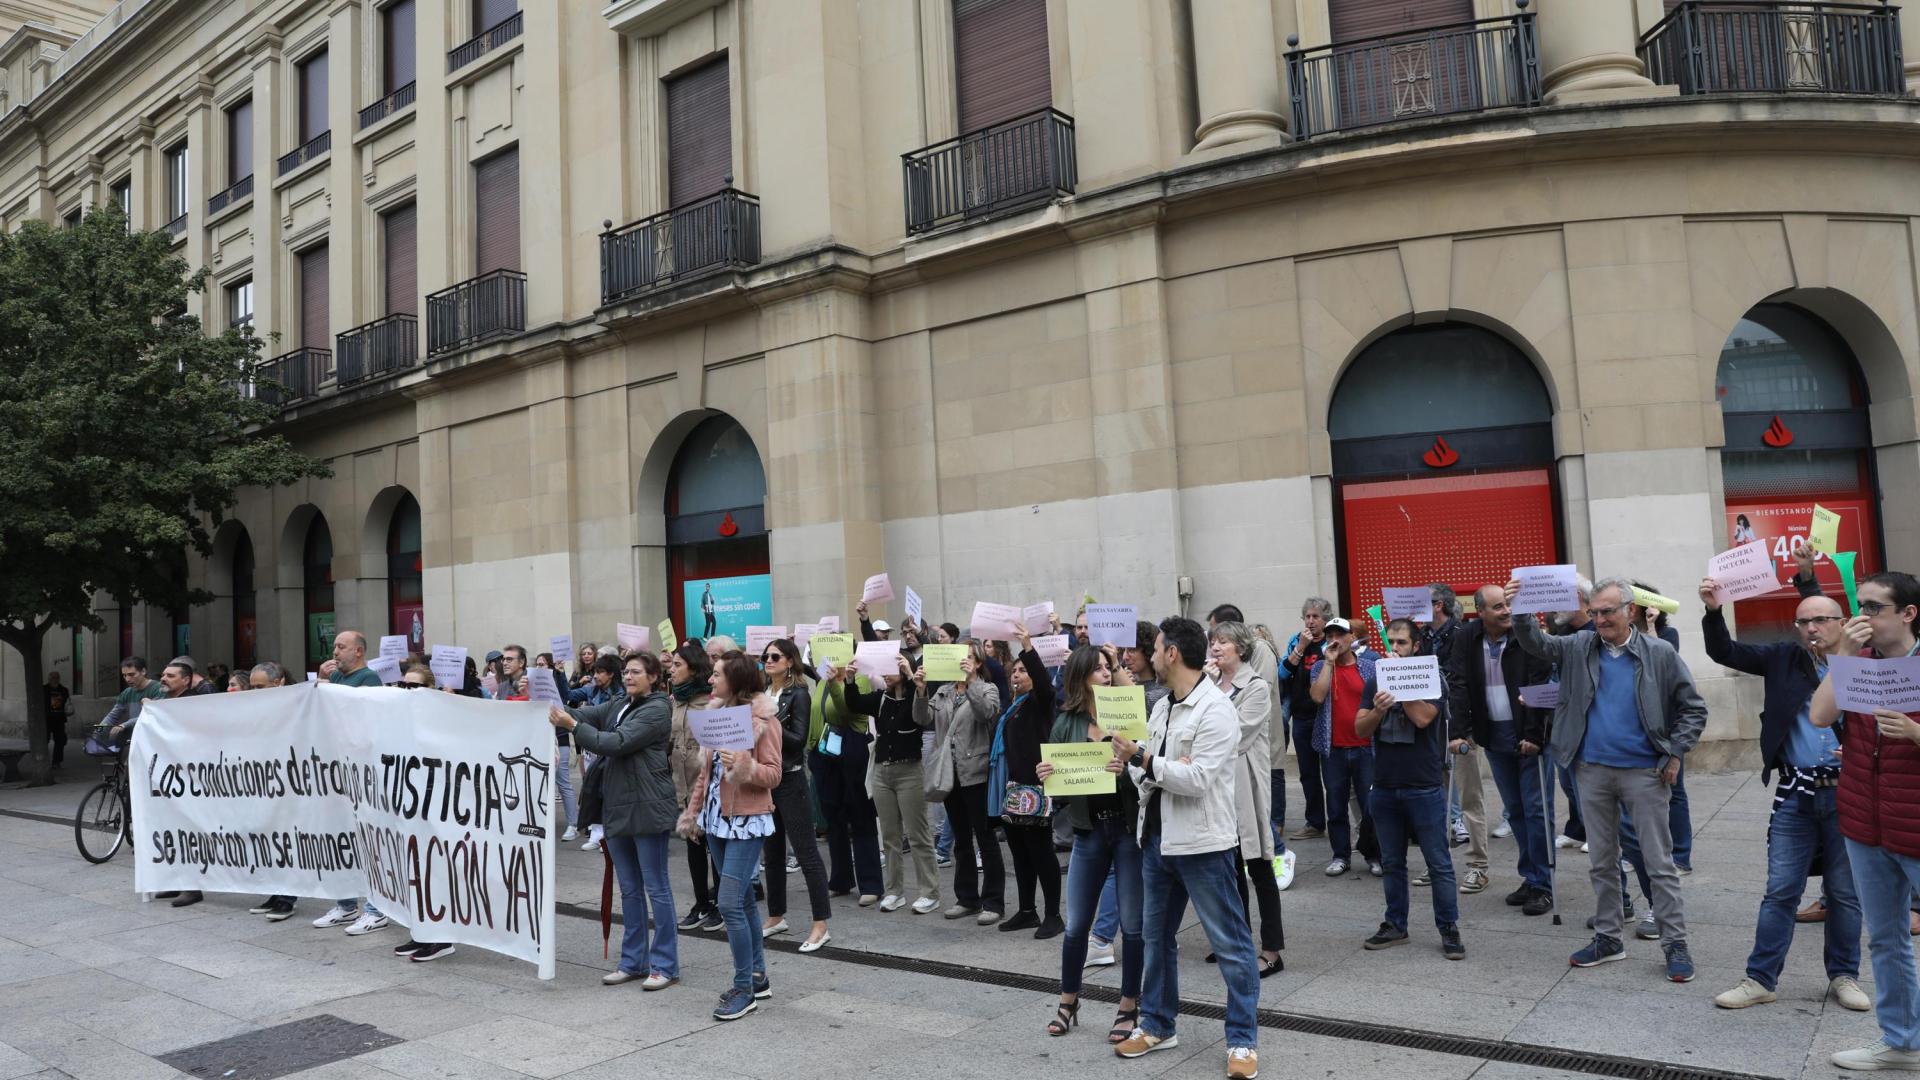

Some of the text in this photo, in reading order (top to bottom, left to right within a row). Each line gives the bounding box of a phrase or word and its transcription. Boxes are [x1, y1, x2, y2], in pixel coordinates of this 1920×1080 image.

[1755, 507, 1813, 517] BIENESTANDO
[1716, 547, 1754, 564] CONSEJERA
[1724, 577, 1750, 589] JUSTICIA
[1761, 571, 1769, 579] TE
[1729, 584, 1759, 595] IMPORTA
[1381, 663, 1434, 672] FUNCIONARIOS
[1397, 673, 1430, 681] JUSTICIA
[1861, 669, 1898, 677] NAVARRA
[1389, 683, 1429, 691] OLVIDADOS
[1852, 677, 1899, 687] DISCRIMINA,
[1846, 684, 1920, 696] LUCHA NO TERMINA
[1063, 777, 1096, 785] SALARIAL
[149, 753, 185, 799] Las
[186, 750, 286, 799] condiciones
[286, 745, 312, 797] de
[380, 753, 504, 835] JUSTICIA
[152, 829, 177, 866] se
[271, 830, 294, 869] se
[294, 825, 361, 882] imponen
